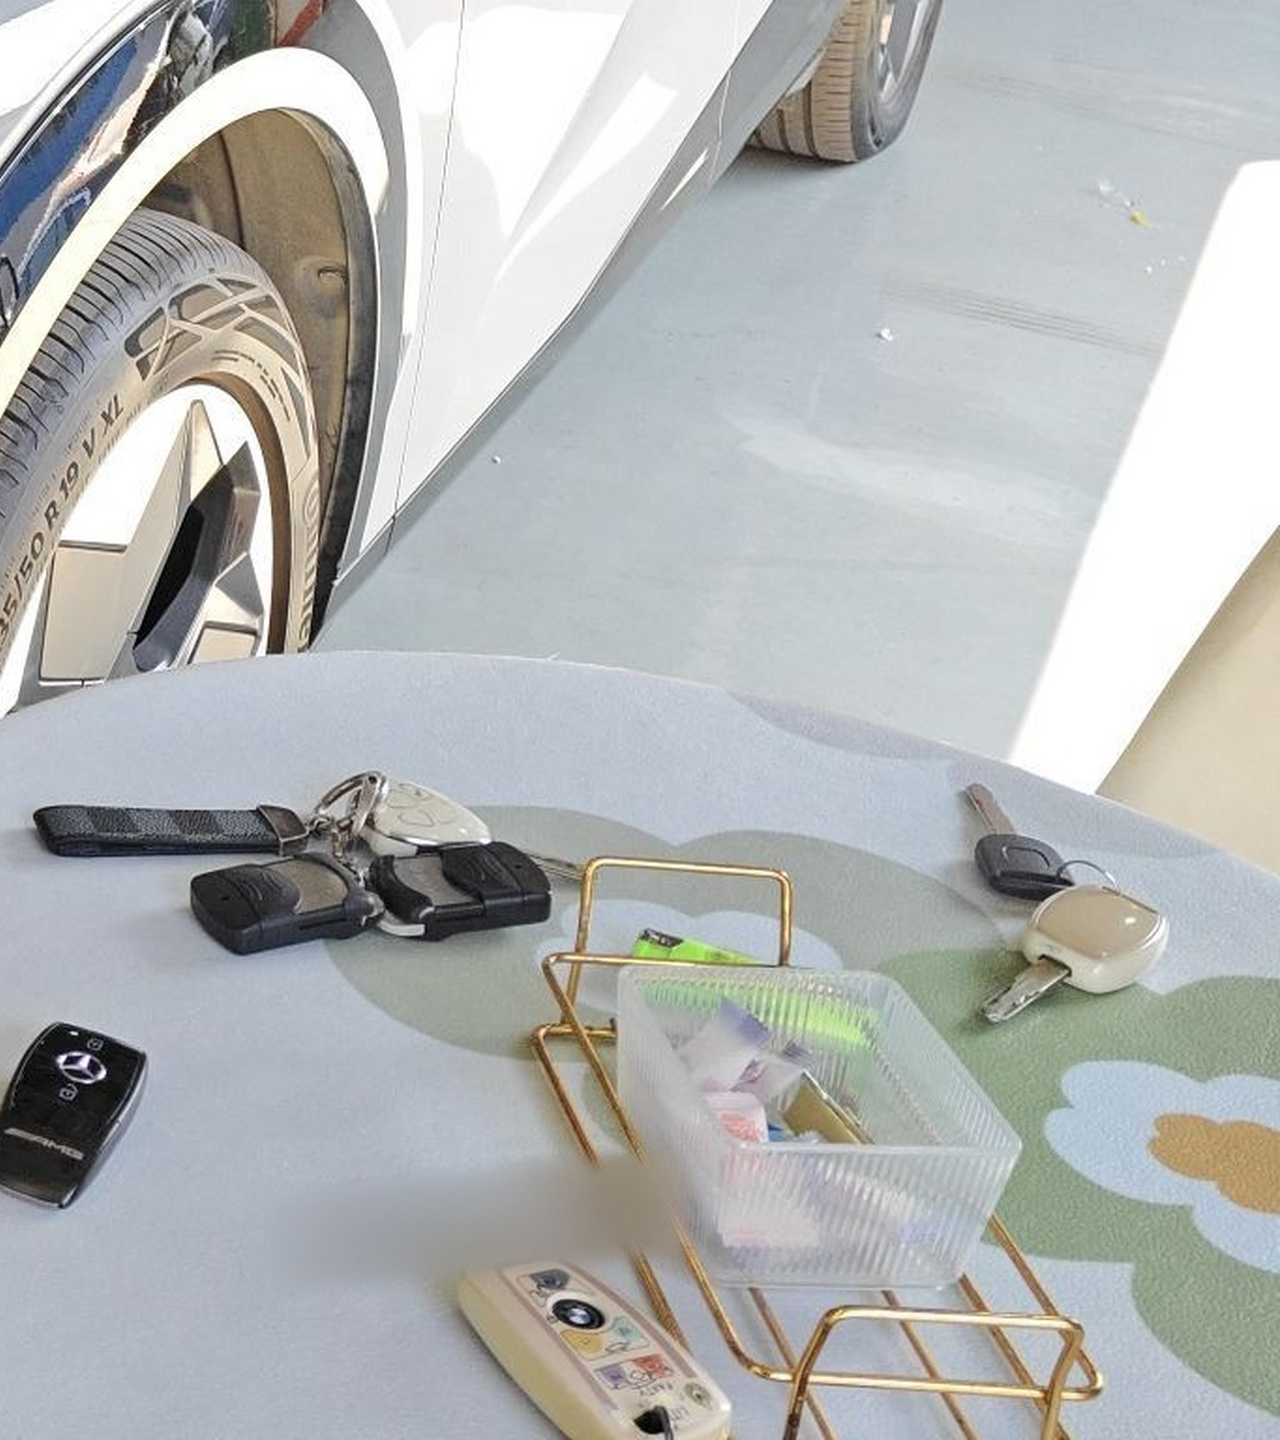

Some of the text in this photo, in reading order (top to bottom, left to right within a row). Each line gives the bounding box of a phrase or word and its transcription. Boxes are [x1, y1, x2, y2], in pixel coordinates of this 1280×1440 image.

[44, 499, 60, 531] R
[58, 460, 80, 499] 19
[81, 428, 97, 460] V
[99, 393, 125, 435] XL
